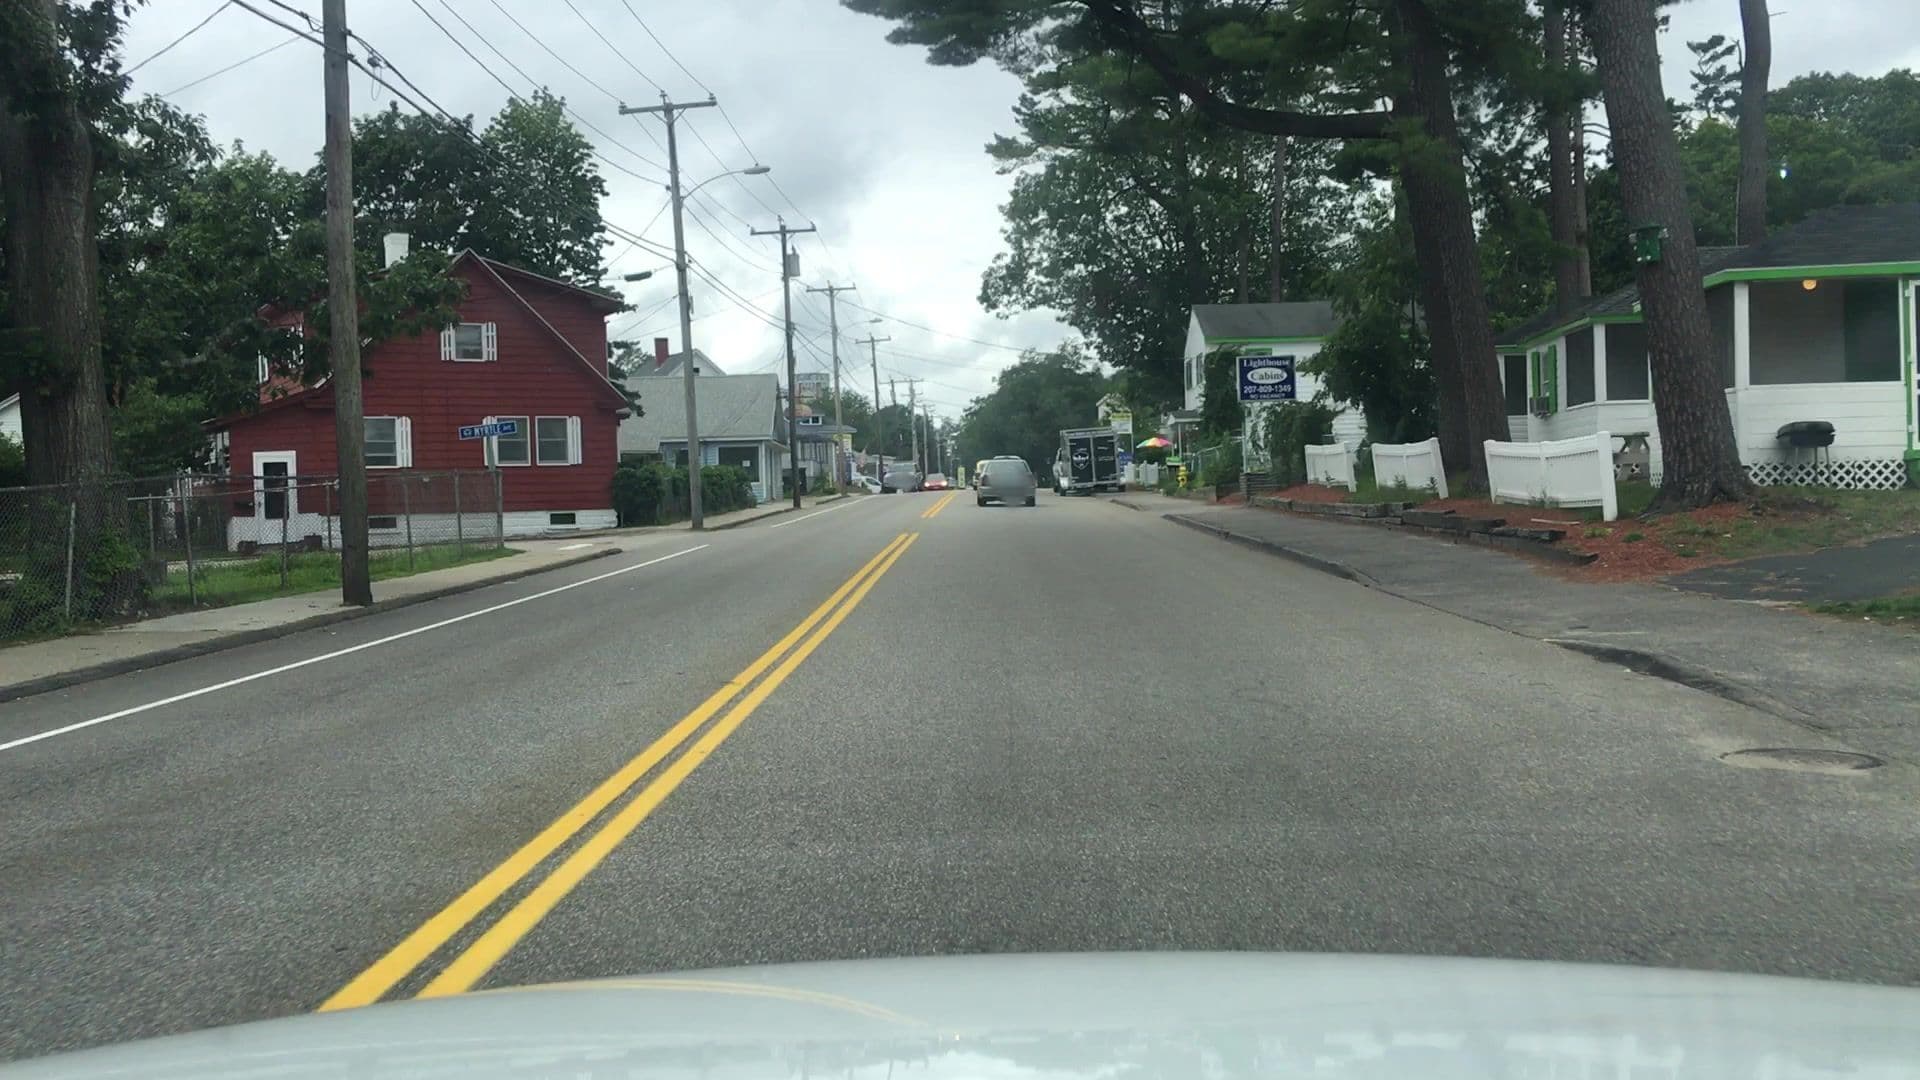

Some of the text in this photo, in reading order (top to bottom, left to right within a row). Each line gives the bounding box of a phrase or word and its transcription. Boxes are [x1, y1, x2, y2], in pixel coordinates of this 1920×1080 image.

[1243, 359, 1289, 368] Lighthouse
[1250, 371, 1284, 380] Cabins
[474, 424, 500, 437] MYRTLE
